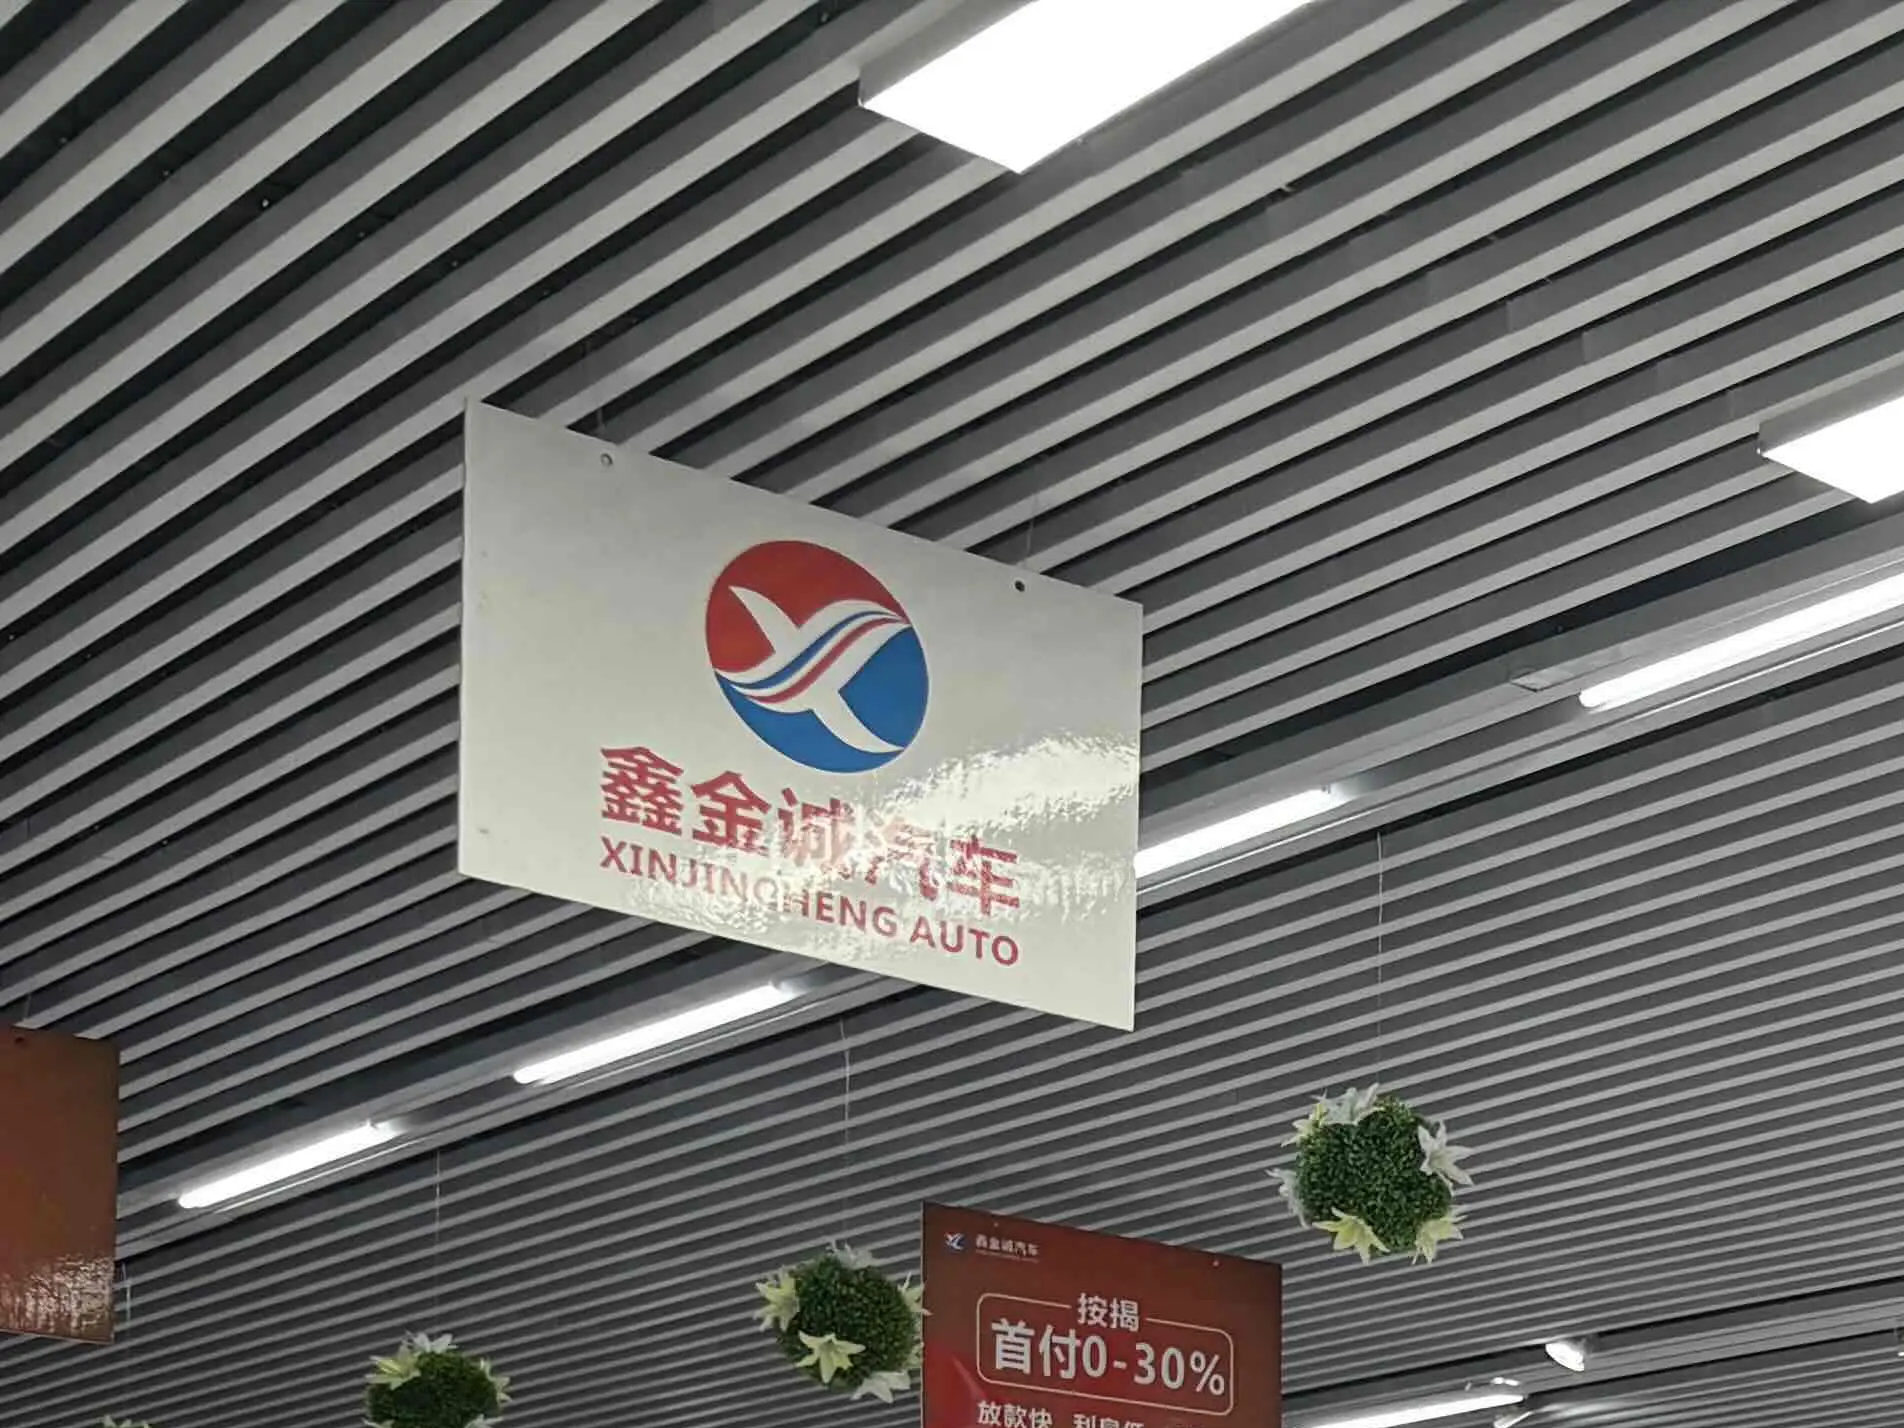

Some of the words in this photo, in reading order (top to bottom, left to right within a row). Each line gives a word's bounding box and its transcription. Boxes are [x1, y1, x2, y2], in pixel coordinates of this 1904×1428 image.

[601, 745, 1020, 916] 鑫金诚汽车
[910, 916, 1018, 966] AUTO
[1077, 1292, 1140, 1332] 按揭
[991, 1318, 1226, 1396] 首付0-30%
